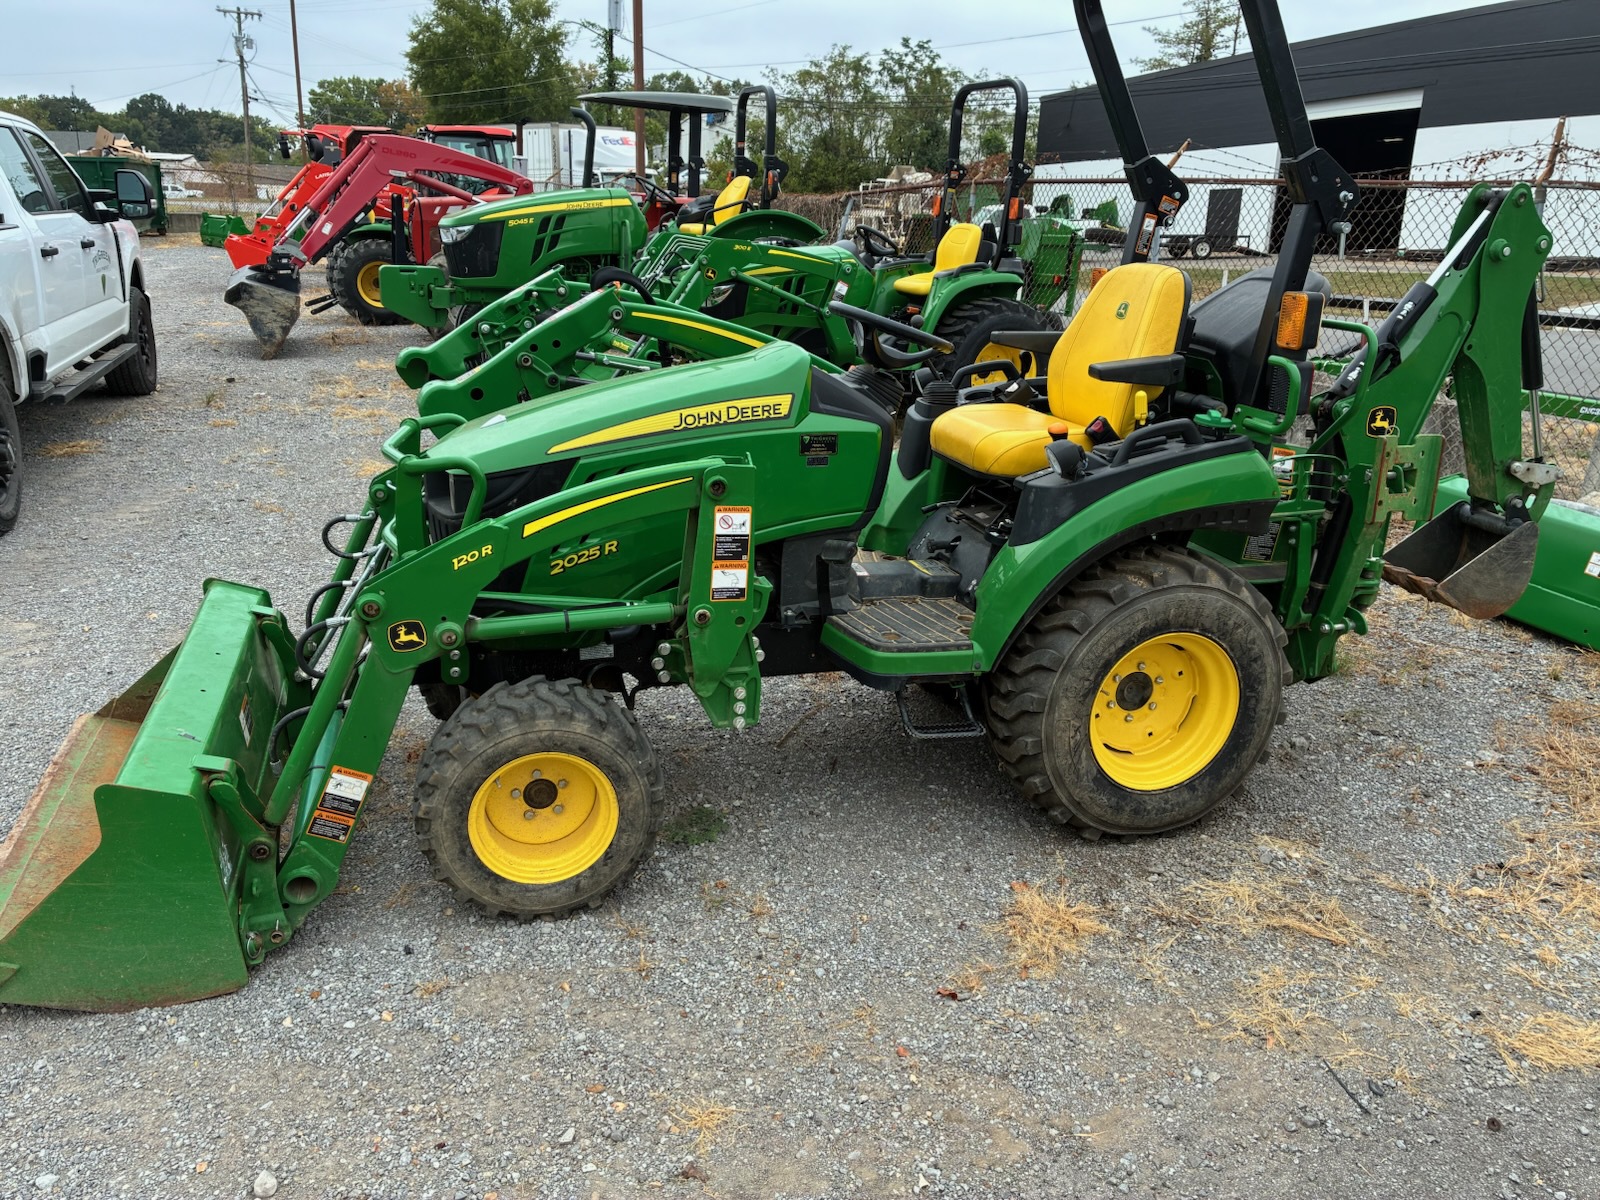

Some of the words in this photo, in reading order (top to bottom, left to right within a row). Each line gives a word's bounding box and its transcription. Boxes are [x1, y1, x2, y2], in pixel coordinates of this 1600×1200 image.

[508, 217, 529, 227] 5045
[673, 410, 722, 429] JOHN
[726, 403, 783, 420] DEERE
[452, 550, 479, 571] 120
[481, 544, 493, 558] R
[550, 545, 601, 576] 2025
[604, 540, 619, 556] R
[343, 769, 368, 780] WARNING
[325, 814, 350, 824] WARNING
